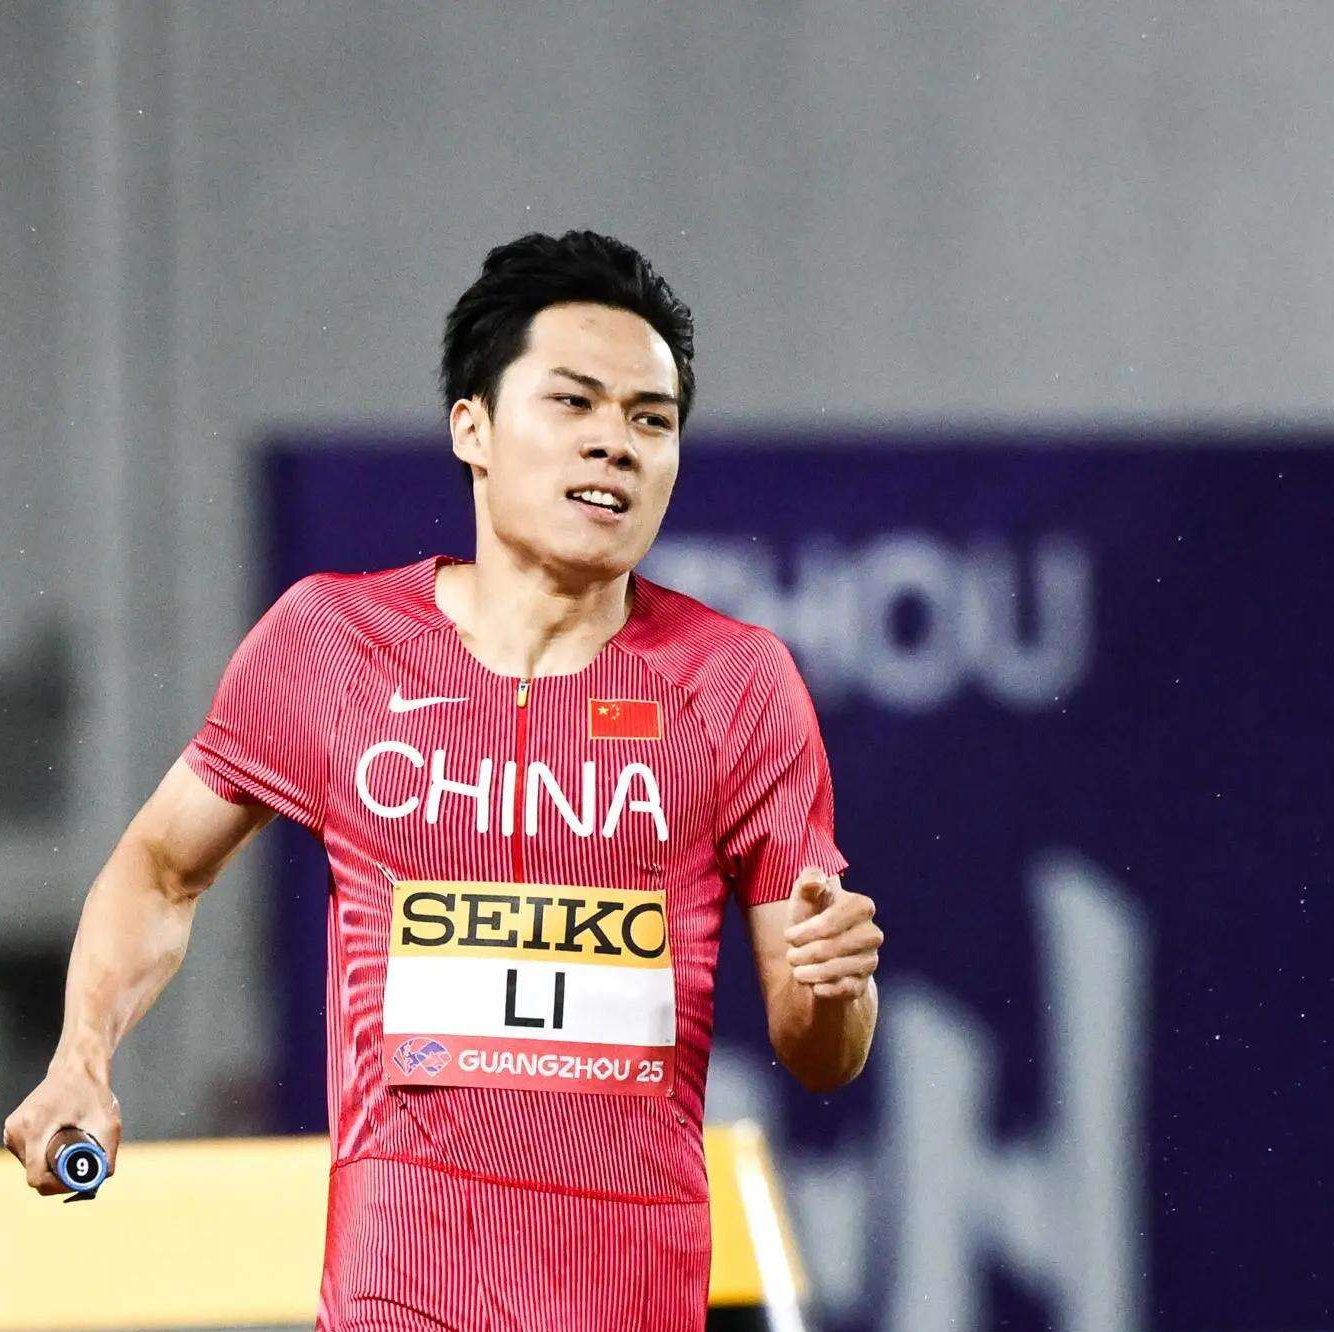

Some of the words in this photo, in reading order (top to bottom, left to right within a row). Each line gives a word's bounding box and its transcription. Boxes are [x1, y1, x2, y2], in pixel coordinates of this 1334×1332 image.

[355, 740, 669, 842] CHINA
[401, 891, 666, 959] SEIKO
[504, 968, 566, 1030] LI
[458, 1049, 631, 1081] GUANGZHOU
[636, 1060, 664, 1083] 25
[76, 1157, 89, 1177] 9
